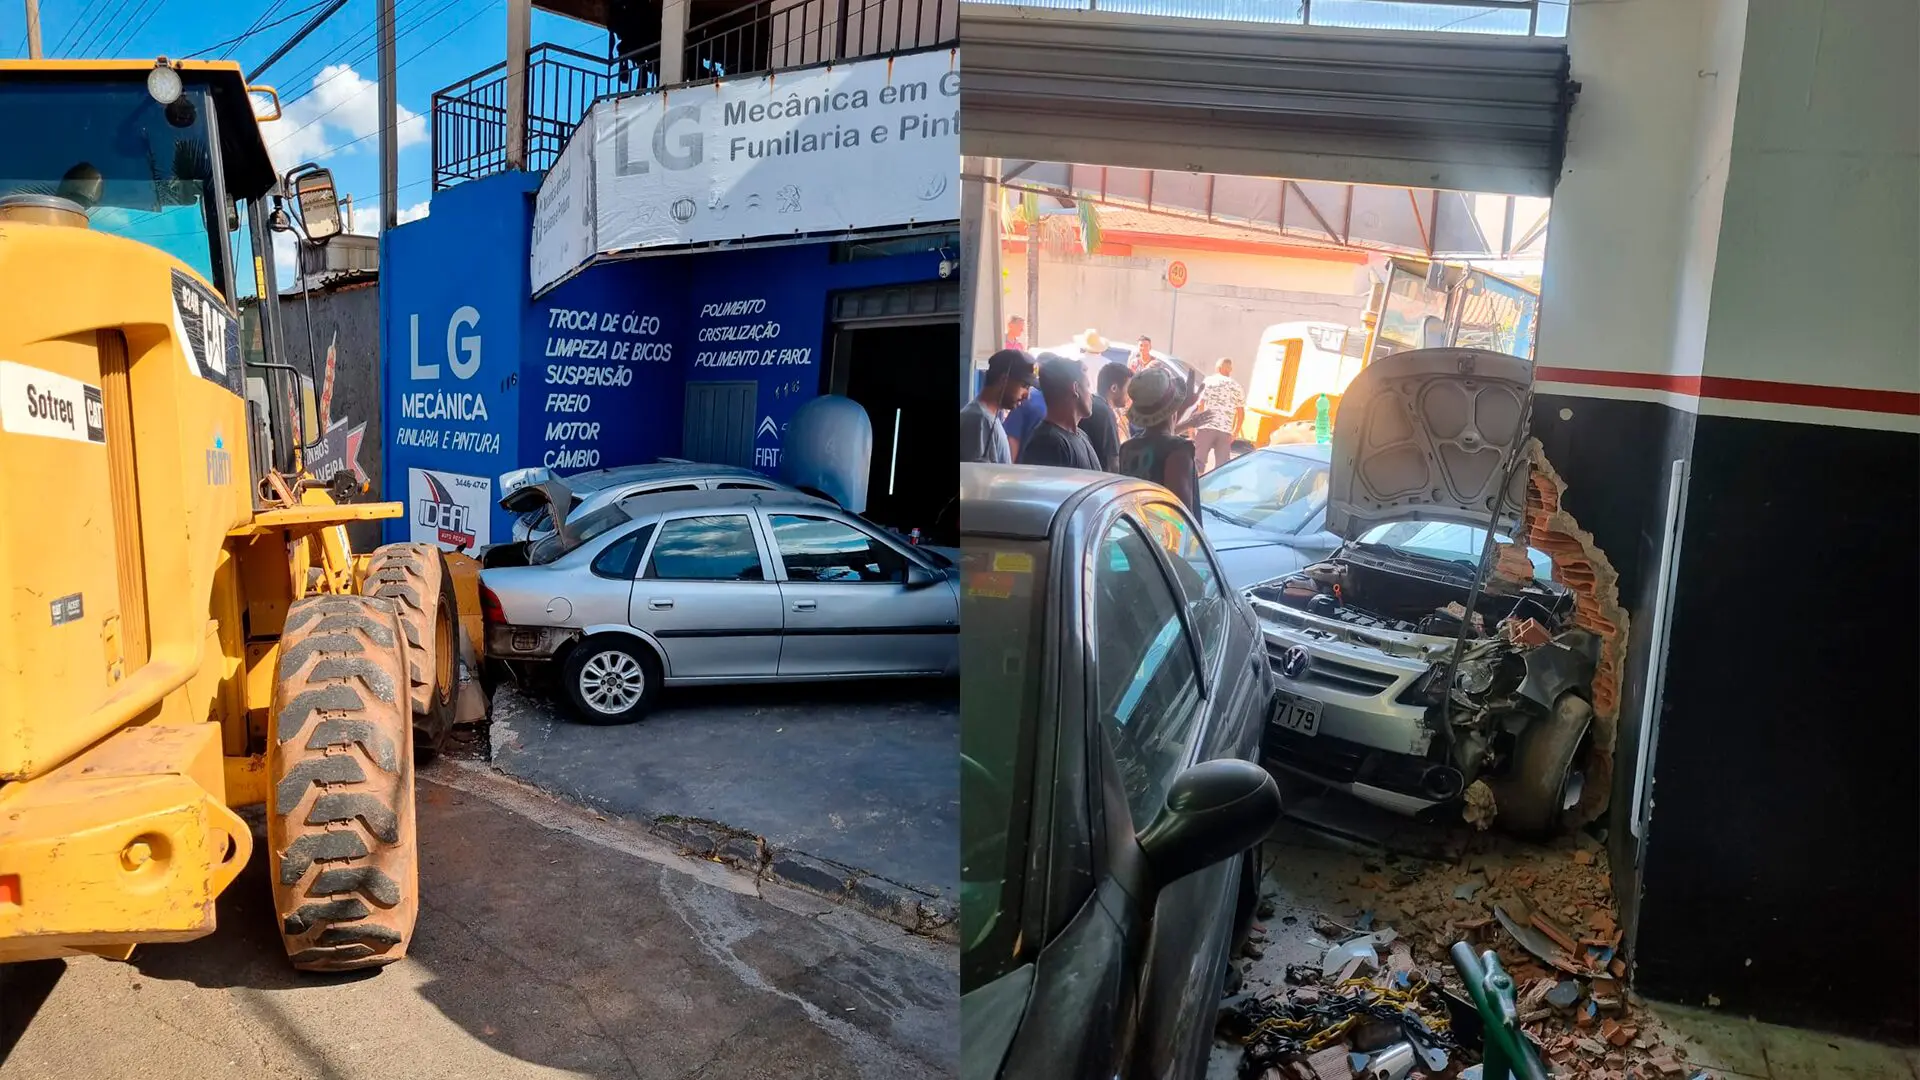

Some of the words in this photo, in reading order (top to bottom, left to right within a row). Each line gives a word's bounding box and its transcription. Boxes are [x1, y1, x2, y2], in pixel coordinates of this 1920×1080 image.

[723, 88, 868, 127] Mecânica
[879, 82, 927, 105] em
[614, 105, 704, 177] LG
[729, 124, 860, 162] Funilaria
[870, 124, 888, 144] e
[1171, 266, 1184, 278] 40
[549, 308, 598, 331] TROCA
[600, 313, 620, 332] DE
[621, 310, 660, 335] ÓLEO
[700, 299, 766, 318] POLIMENTO
[202, 300, 227, 376] CAT
[410, 305, 481, 380] LG
[698, 321, 780, 341] CRISTALIZAÇÃO
[545, 337, 608, 360] LIMPEZA
[611, 341, 630, 360] DE
[631, 342, 672, 362] BICOS
[694, 350, 759, 367] POLIMENTO
[760, 349, 776, 366] DE
[777, 348, 812, 366] FAROL
[545, 365, 633, 387] SUSPENSÃO
[27, 383, 75, 431] Sotreq
[86, 397, 103, 429] CAT
[545, 393, 591, 412] FREIO
[396, 427, 439, 448] FUNILARIA
[442, 430, 450, 449] E
[452, 431, 500, 454] PINTURA
[545, 422, 600, 441] MOTOR
[543, 444, 600, 469] CÂMBIO
[755, 447, 780, 467] FIAT
[418, 499, 476, 536] IDEAL
[1277, 702, 1316, 731] 7179
